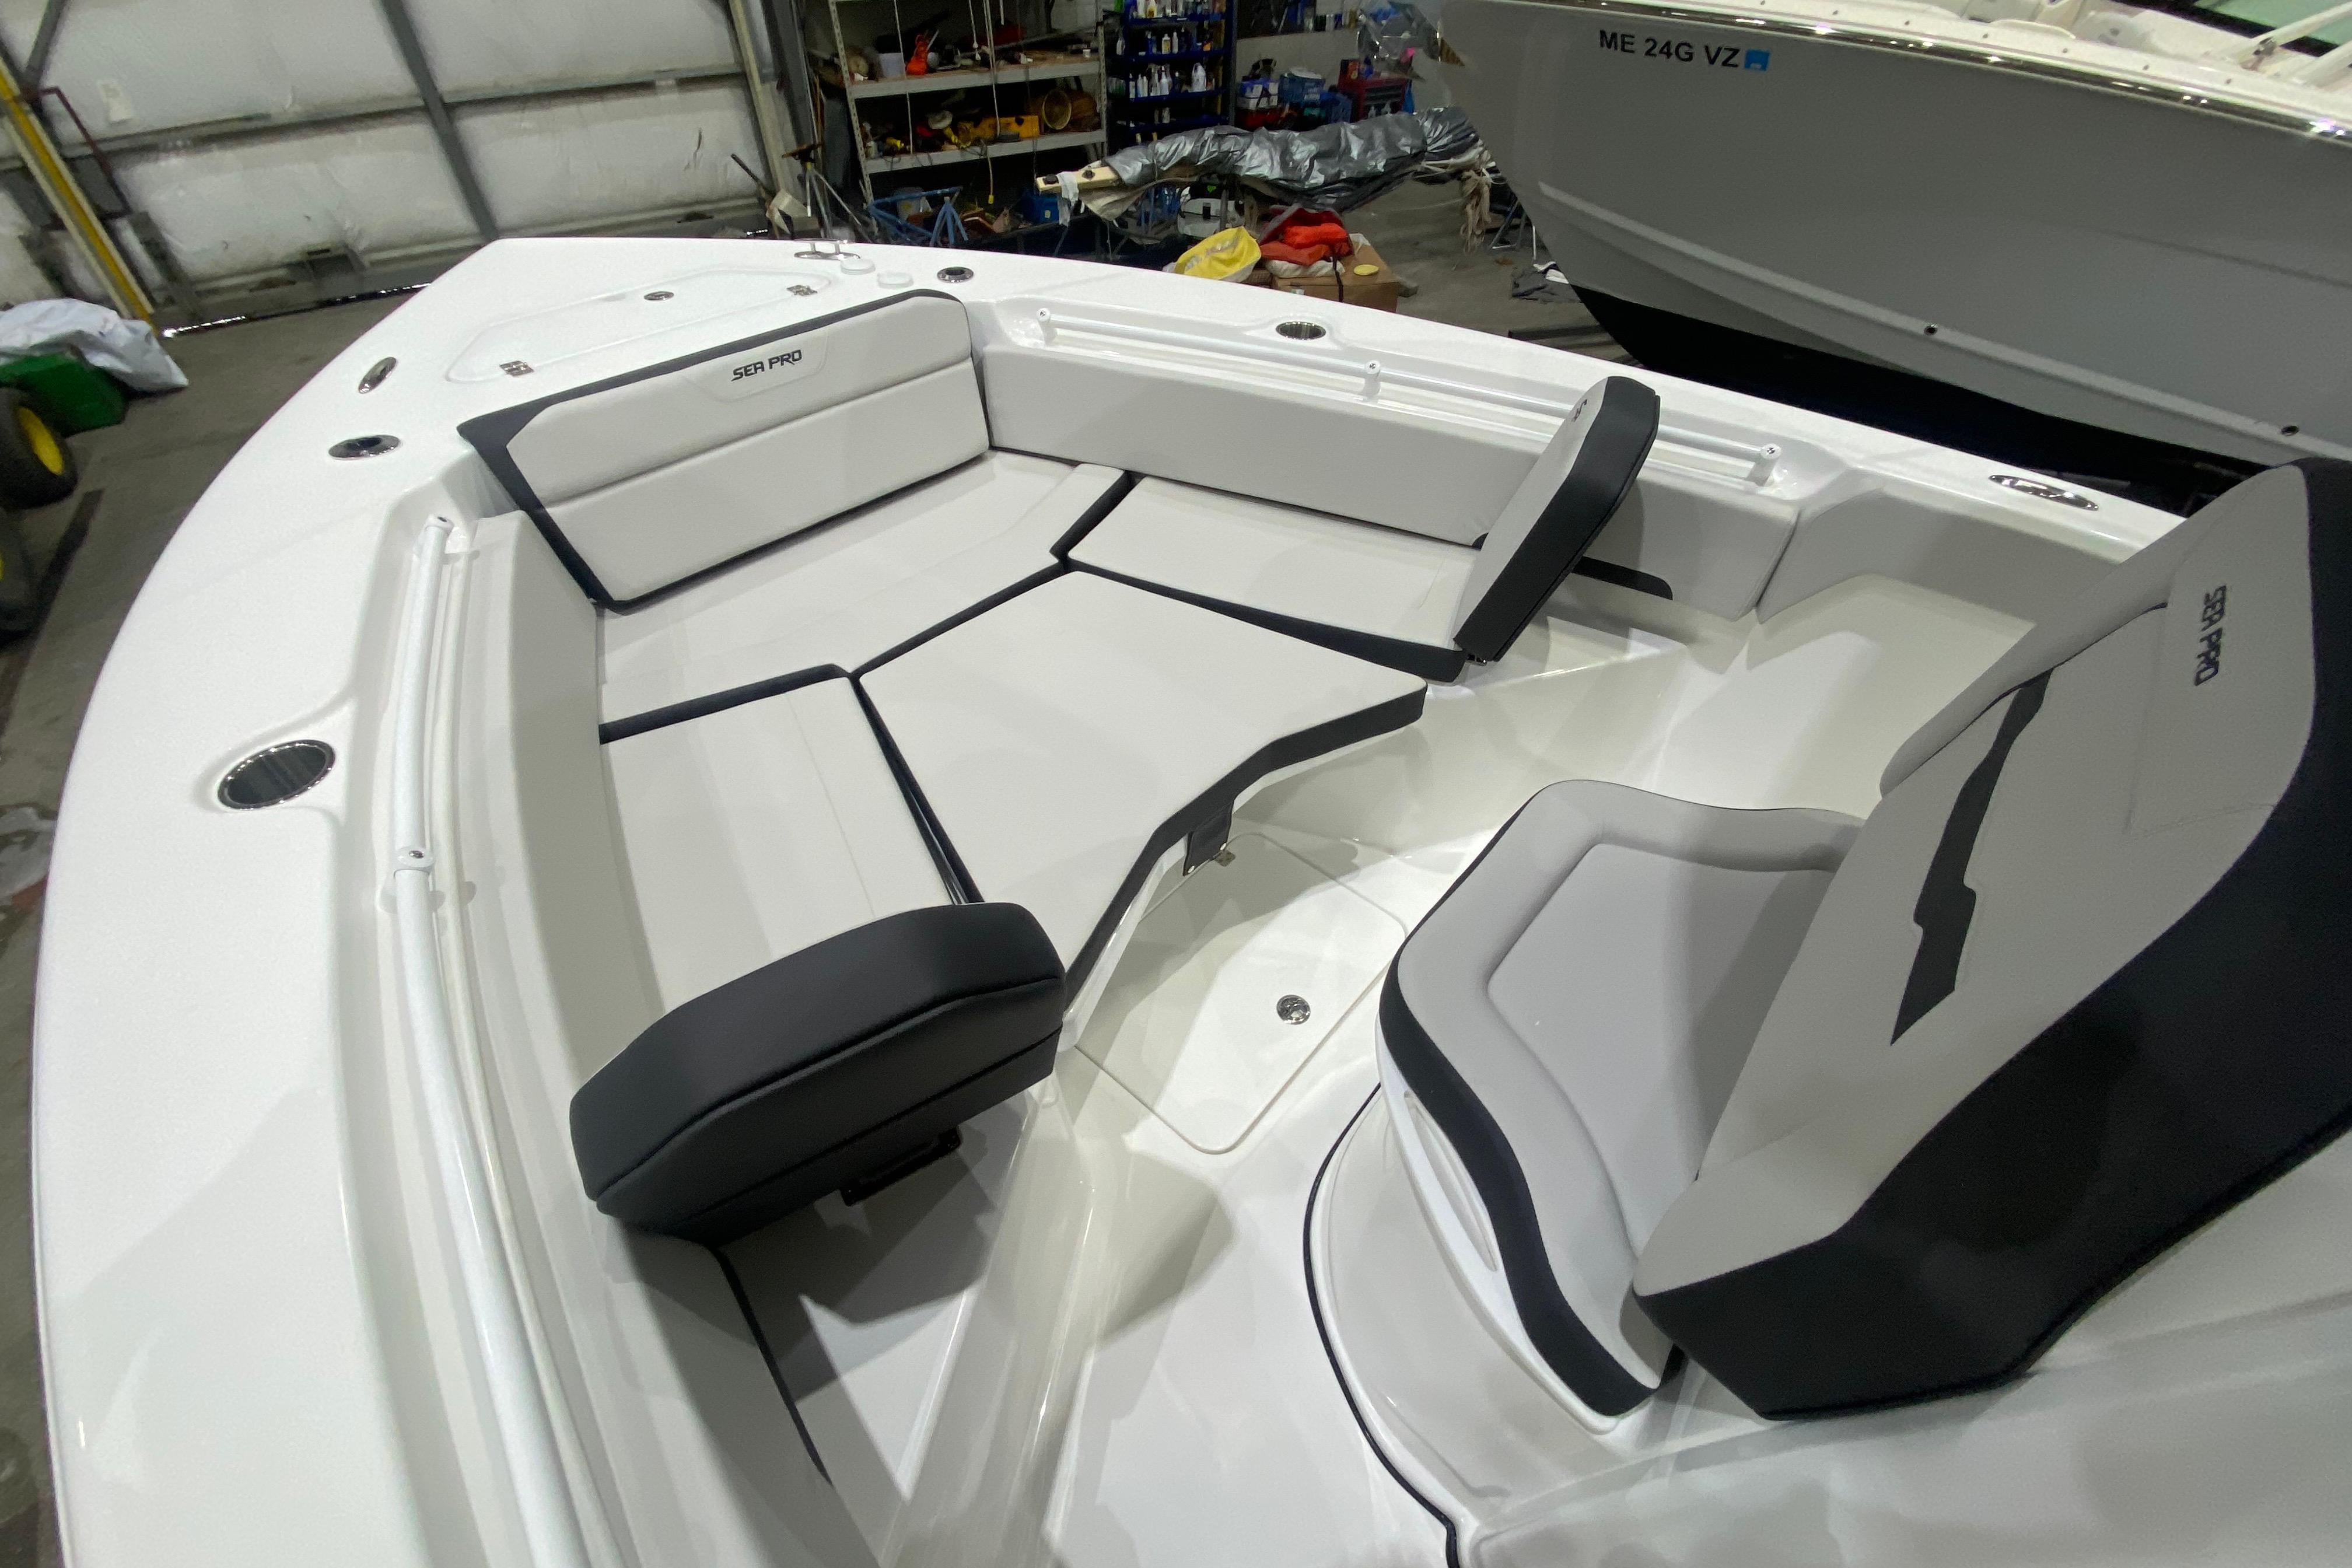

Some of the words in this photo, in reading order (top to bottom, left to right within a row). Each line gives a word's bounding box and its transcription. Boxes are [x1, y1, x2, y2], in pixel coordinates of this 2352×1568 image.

[1600, 30, 1635, 53] ME
[1644, 37, 1694, 62] 24G
[1704, 45, 1740, 68] VZ
[731, 360, 765, 382] SEA
[768, 349, 802, 369] PRO
[2201, 584, 2227, 632] SEA
[2193, 627, 2223, 686] PRO
